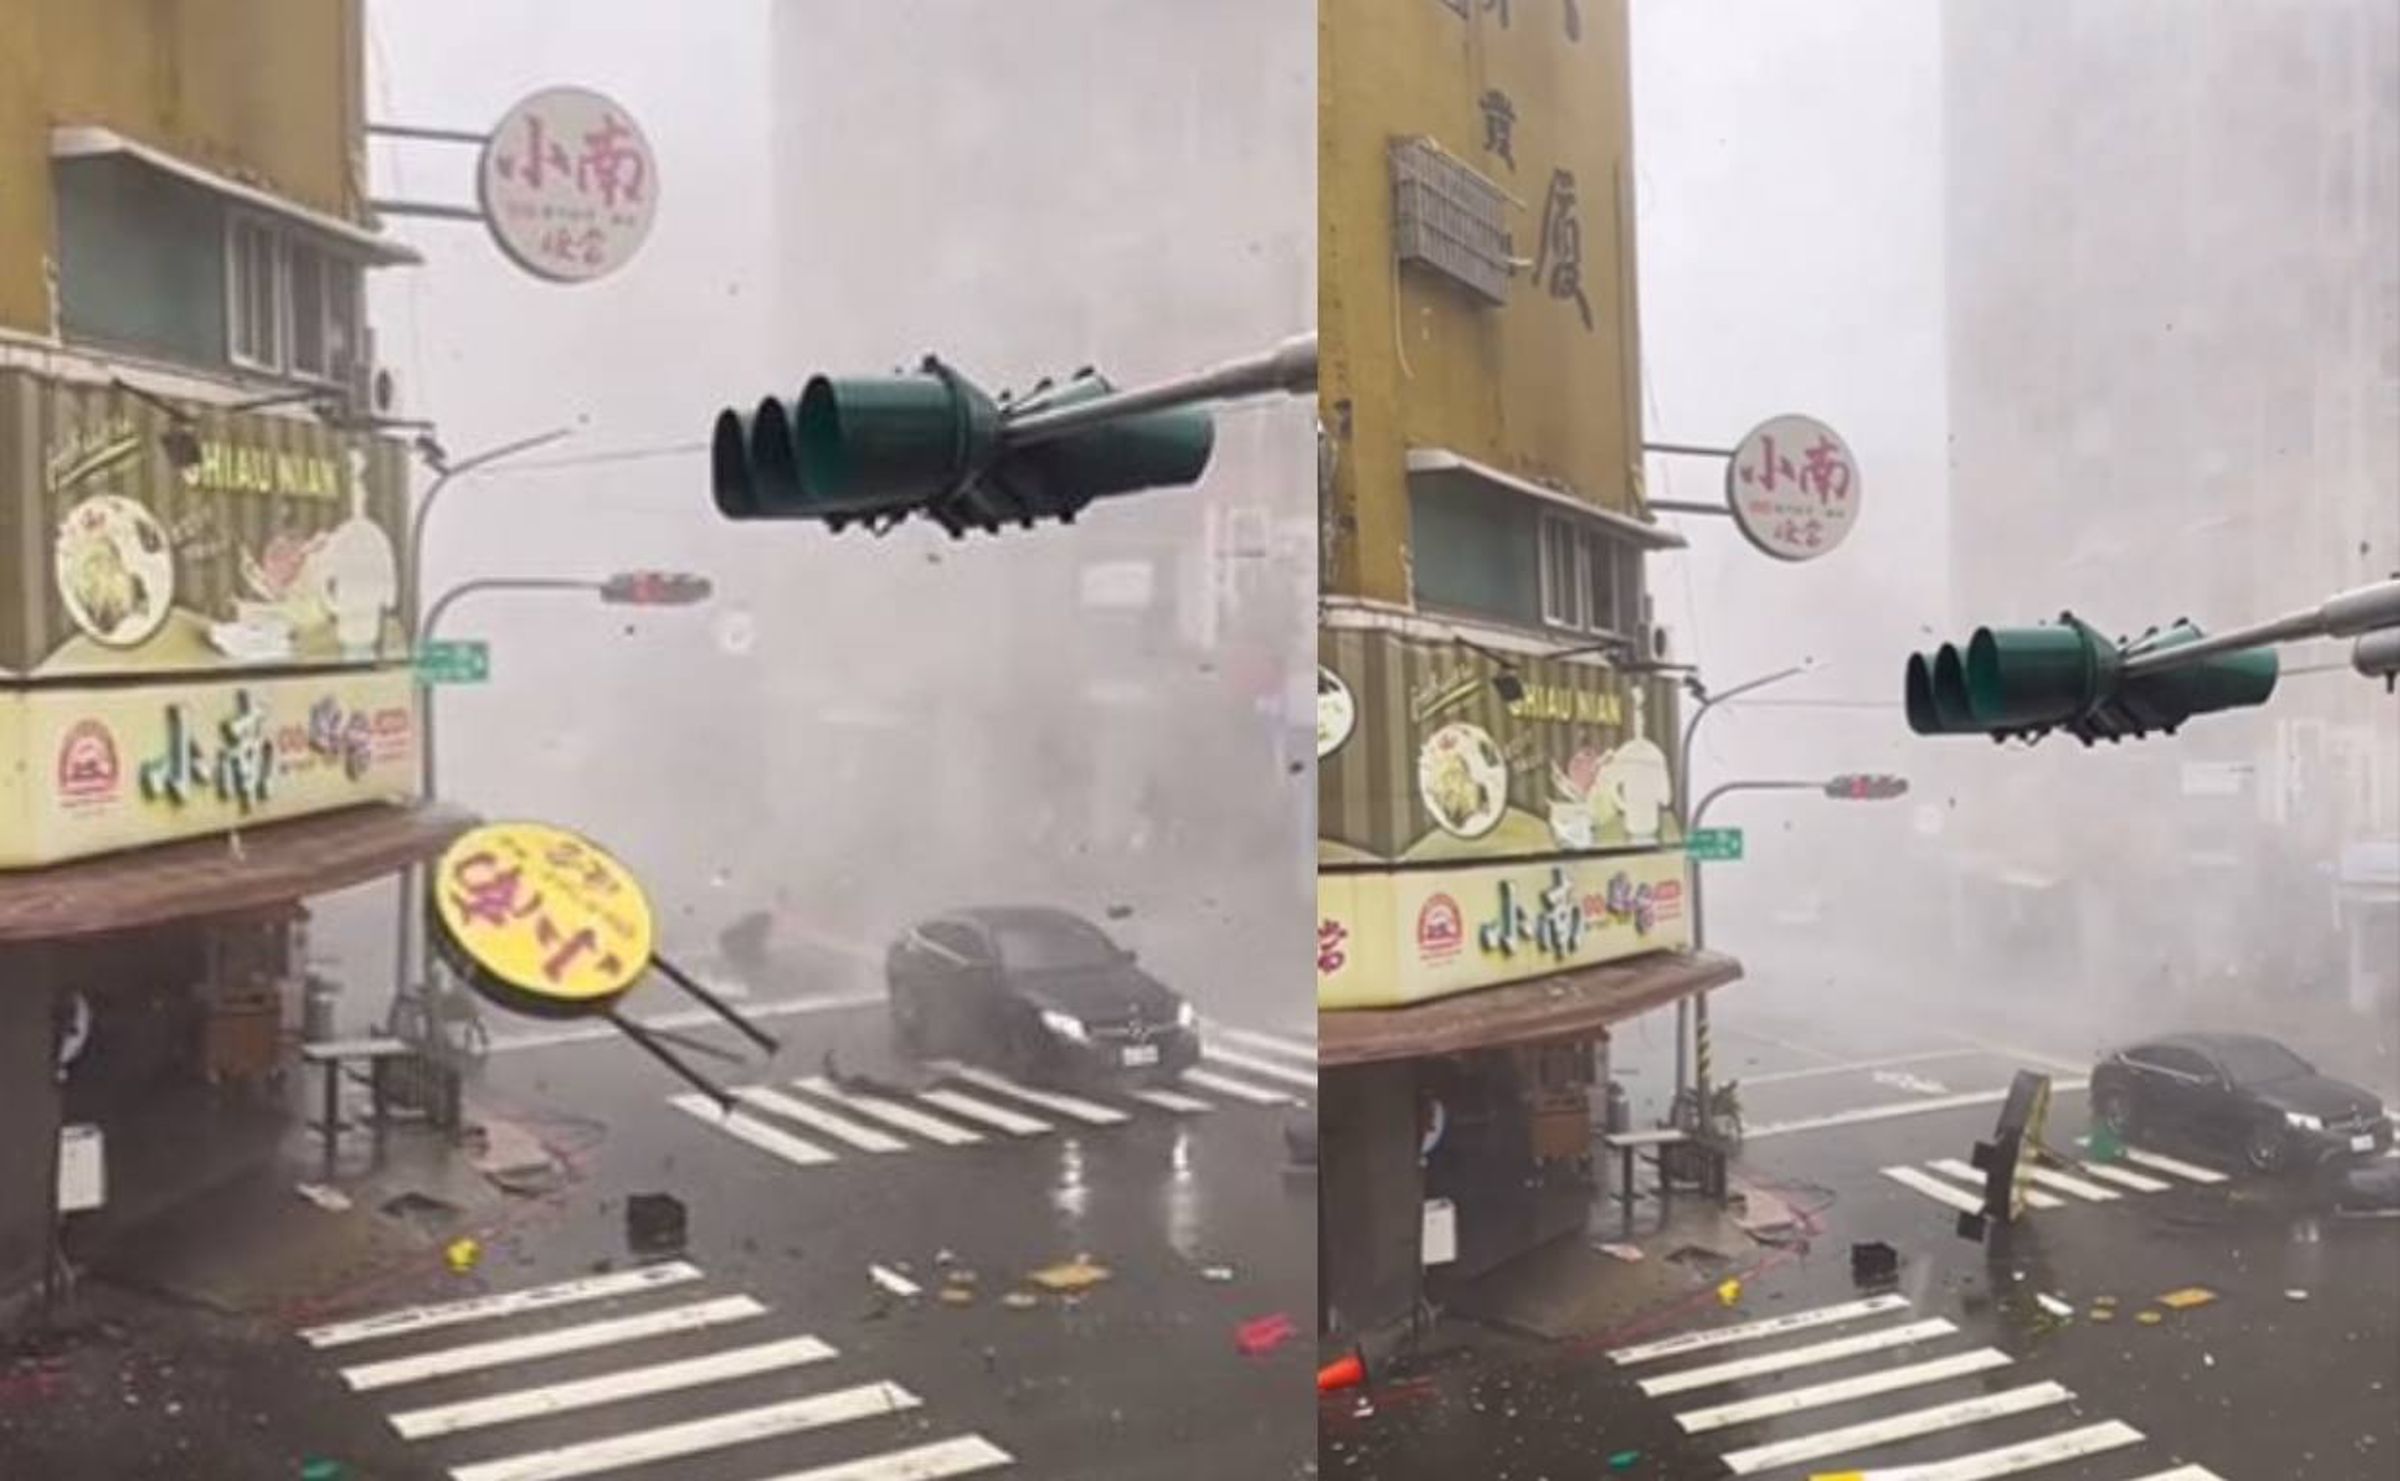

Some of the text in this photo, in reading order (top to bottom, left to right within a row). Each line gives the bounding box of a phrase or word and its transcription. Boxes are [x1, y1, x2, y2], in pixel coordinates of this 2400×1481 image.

[496, 113, 643, 207] 小南
[1740, 434, 1850, 505] 小南
[141, 689, 273, 816] 小南
[1480, 867, 1580, 962] 小南
